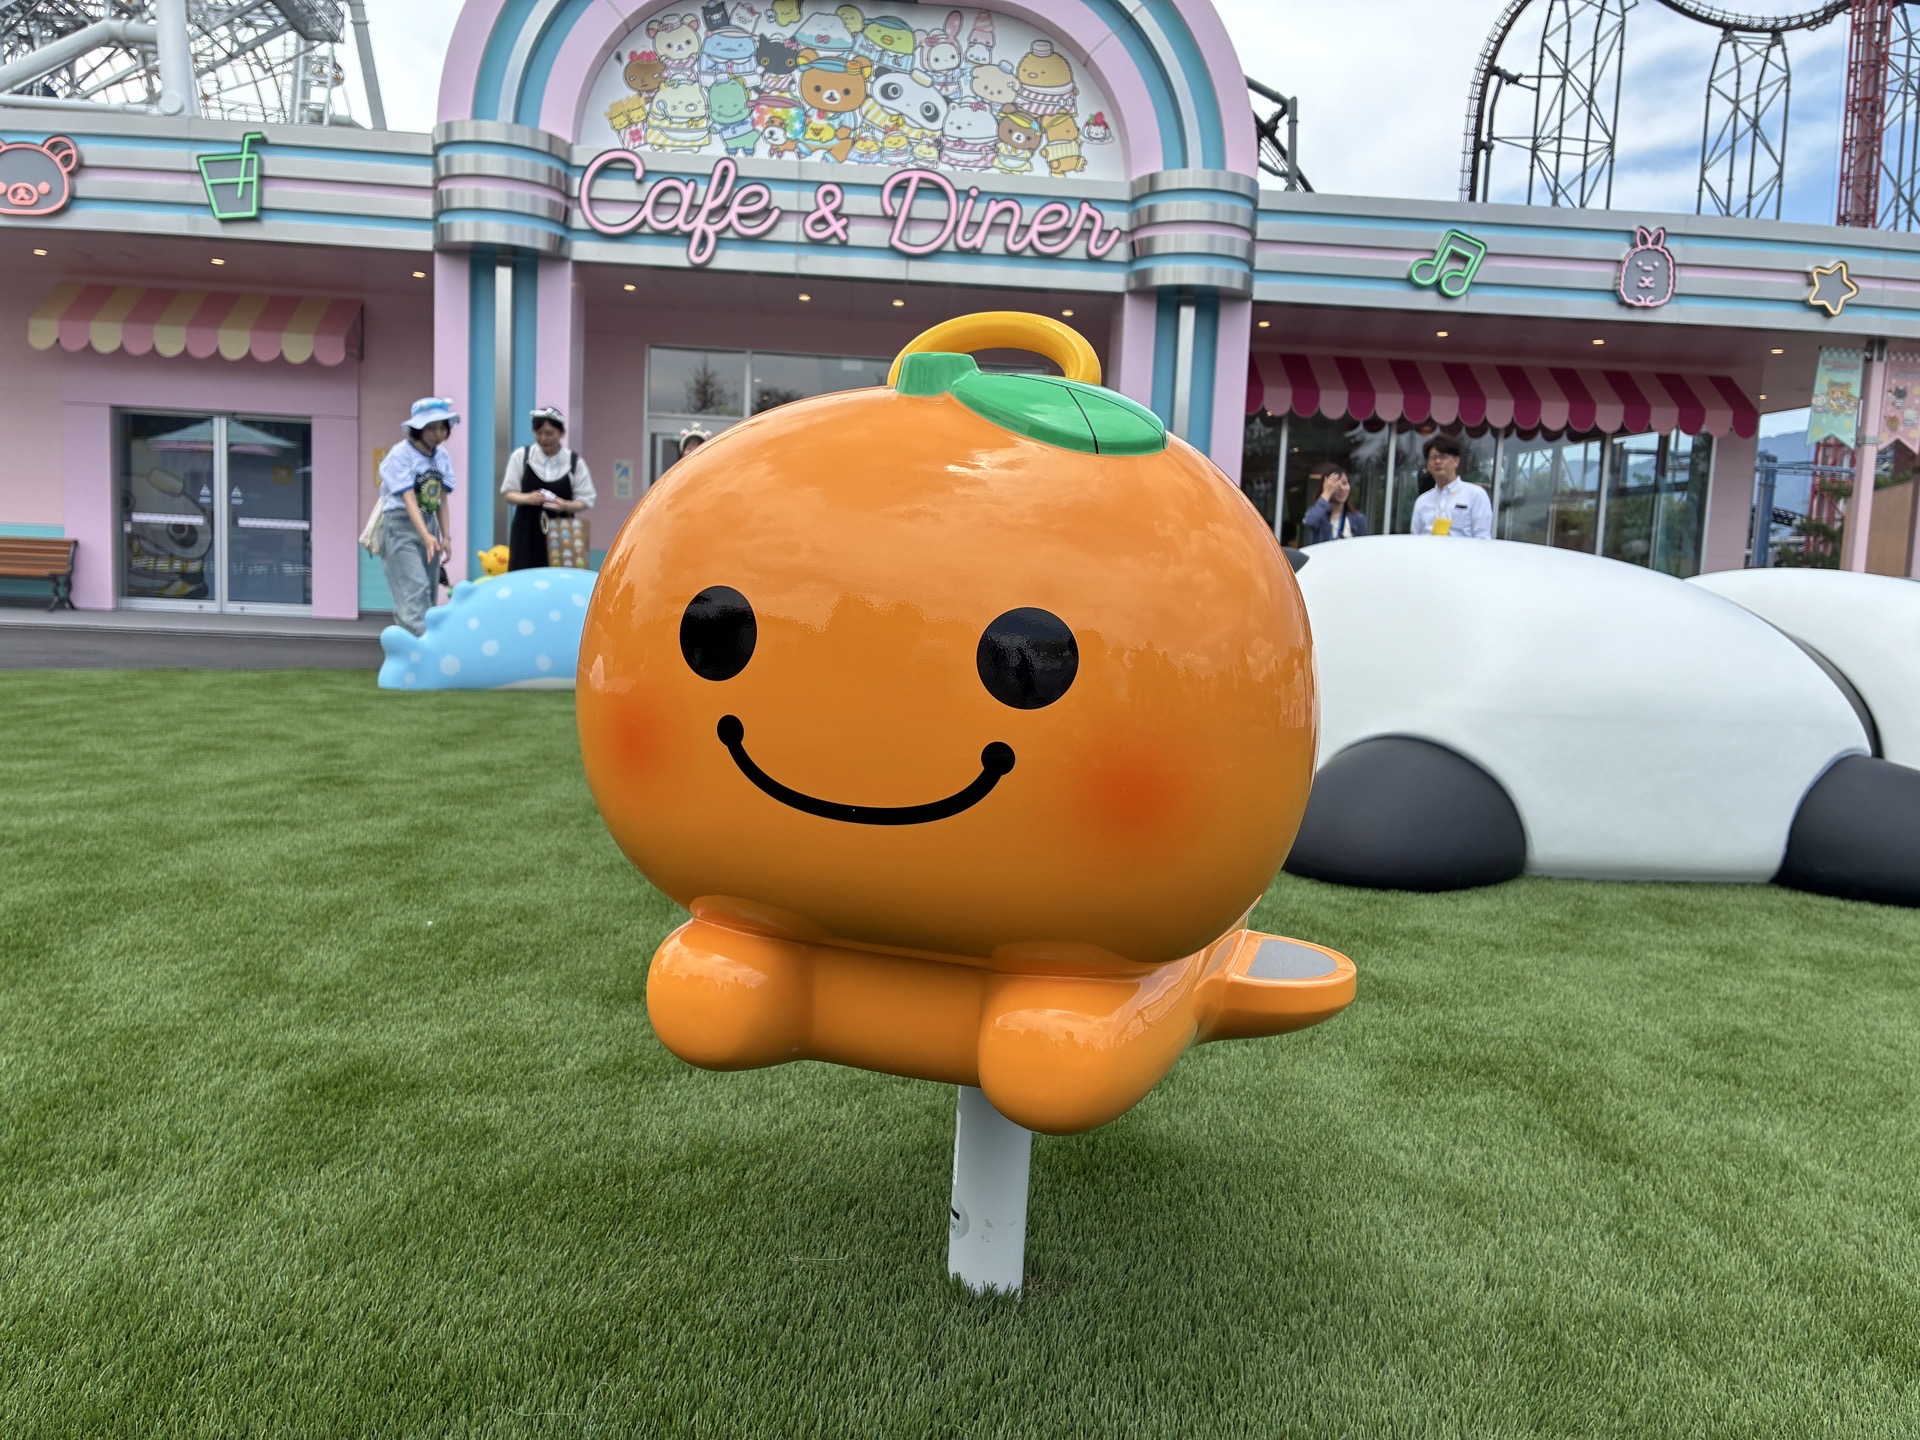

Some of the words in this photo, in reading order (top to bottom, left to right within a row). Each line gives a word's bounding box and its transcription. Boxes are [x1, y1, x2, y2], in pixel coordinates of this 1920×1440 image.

[579, 149, 782, 265] Cafe
[803, 182, 850, 243] &
[881, 167, 1122, 258] Diner
